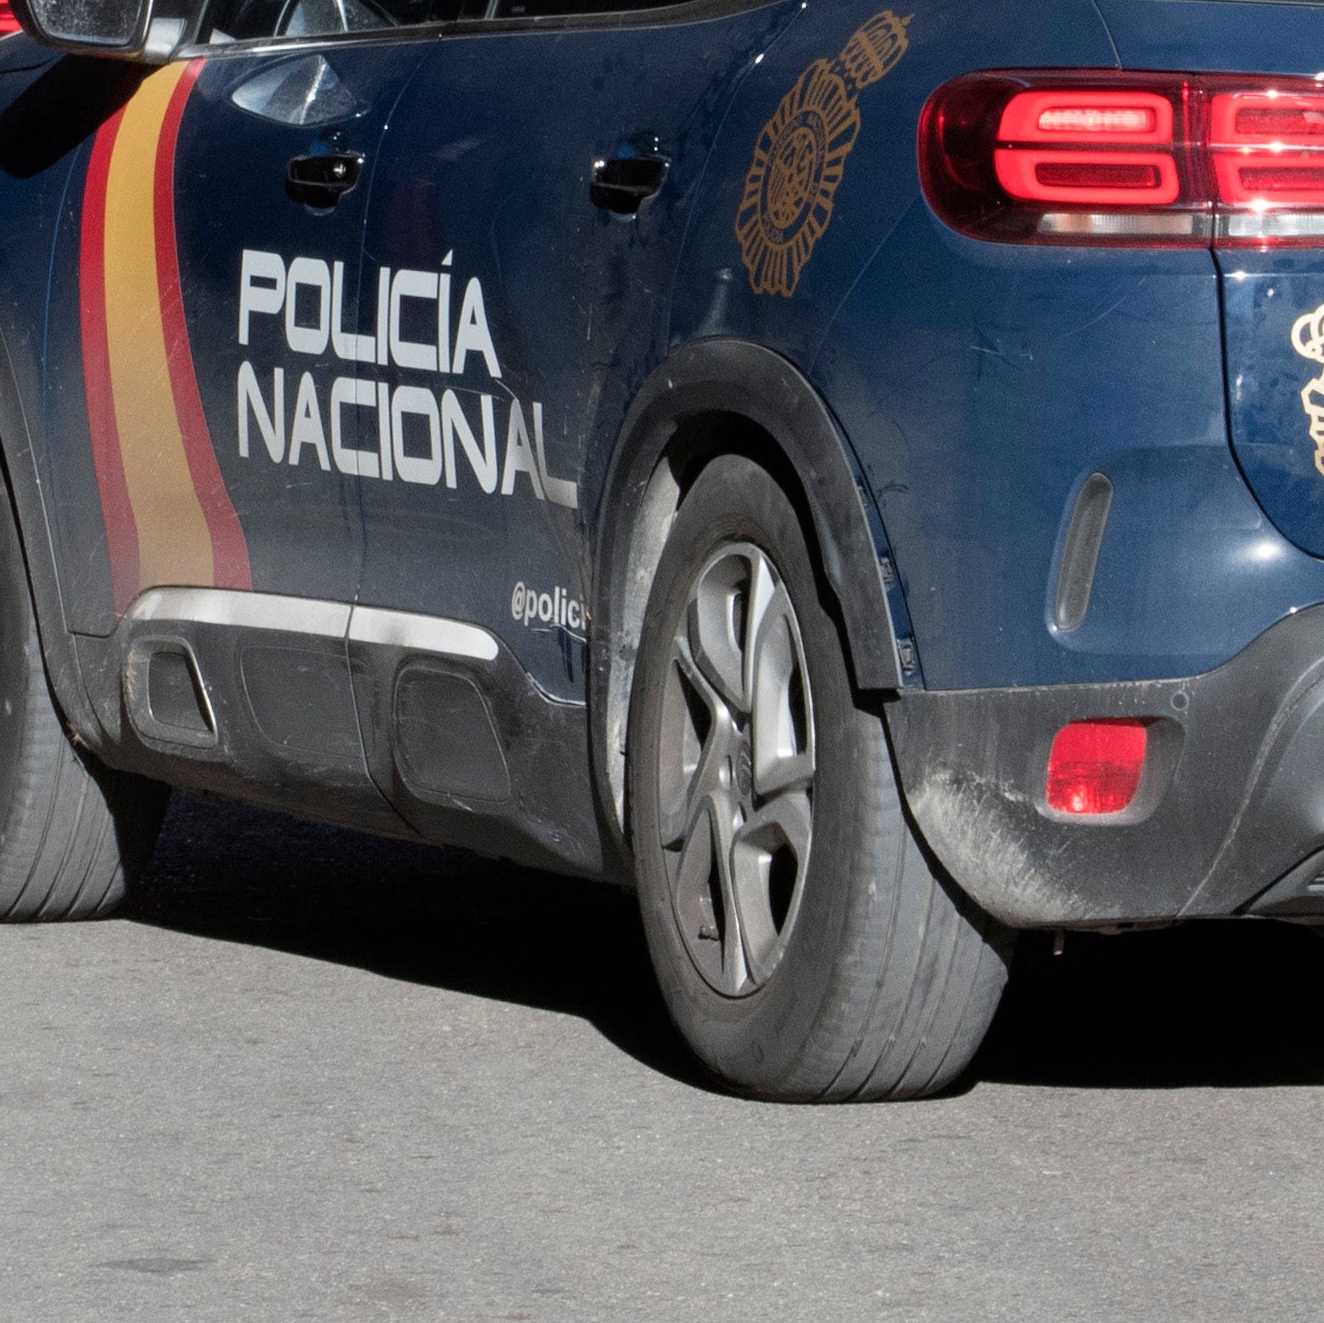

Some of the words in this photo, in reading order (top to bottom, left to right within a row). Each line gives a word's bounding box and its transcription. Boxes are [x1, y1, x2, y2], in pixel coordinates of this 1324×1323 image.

[238, 249, 502, 379] POLICÍA
[237, 360, 579, 509] NACIONAL
[511, 581, 587, 630] @polici
